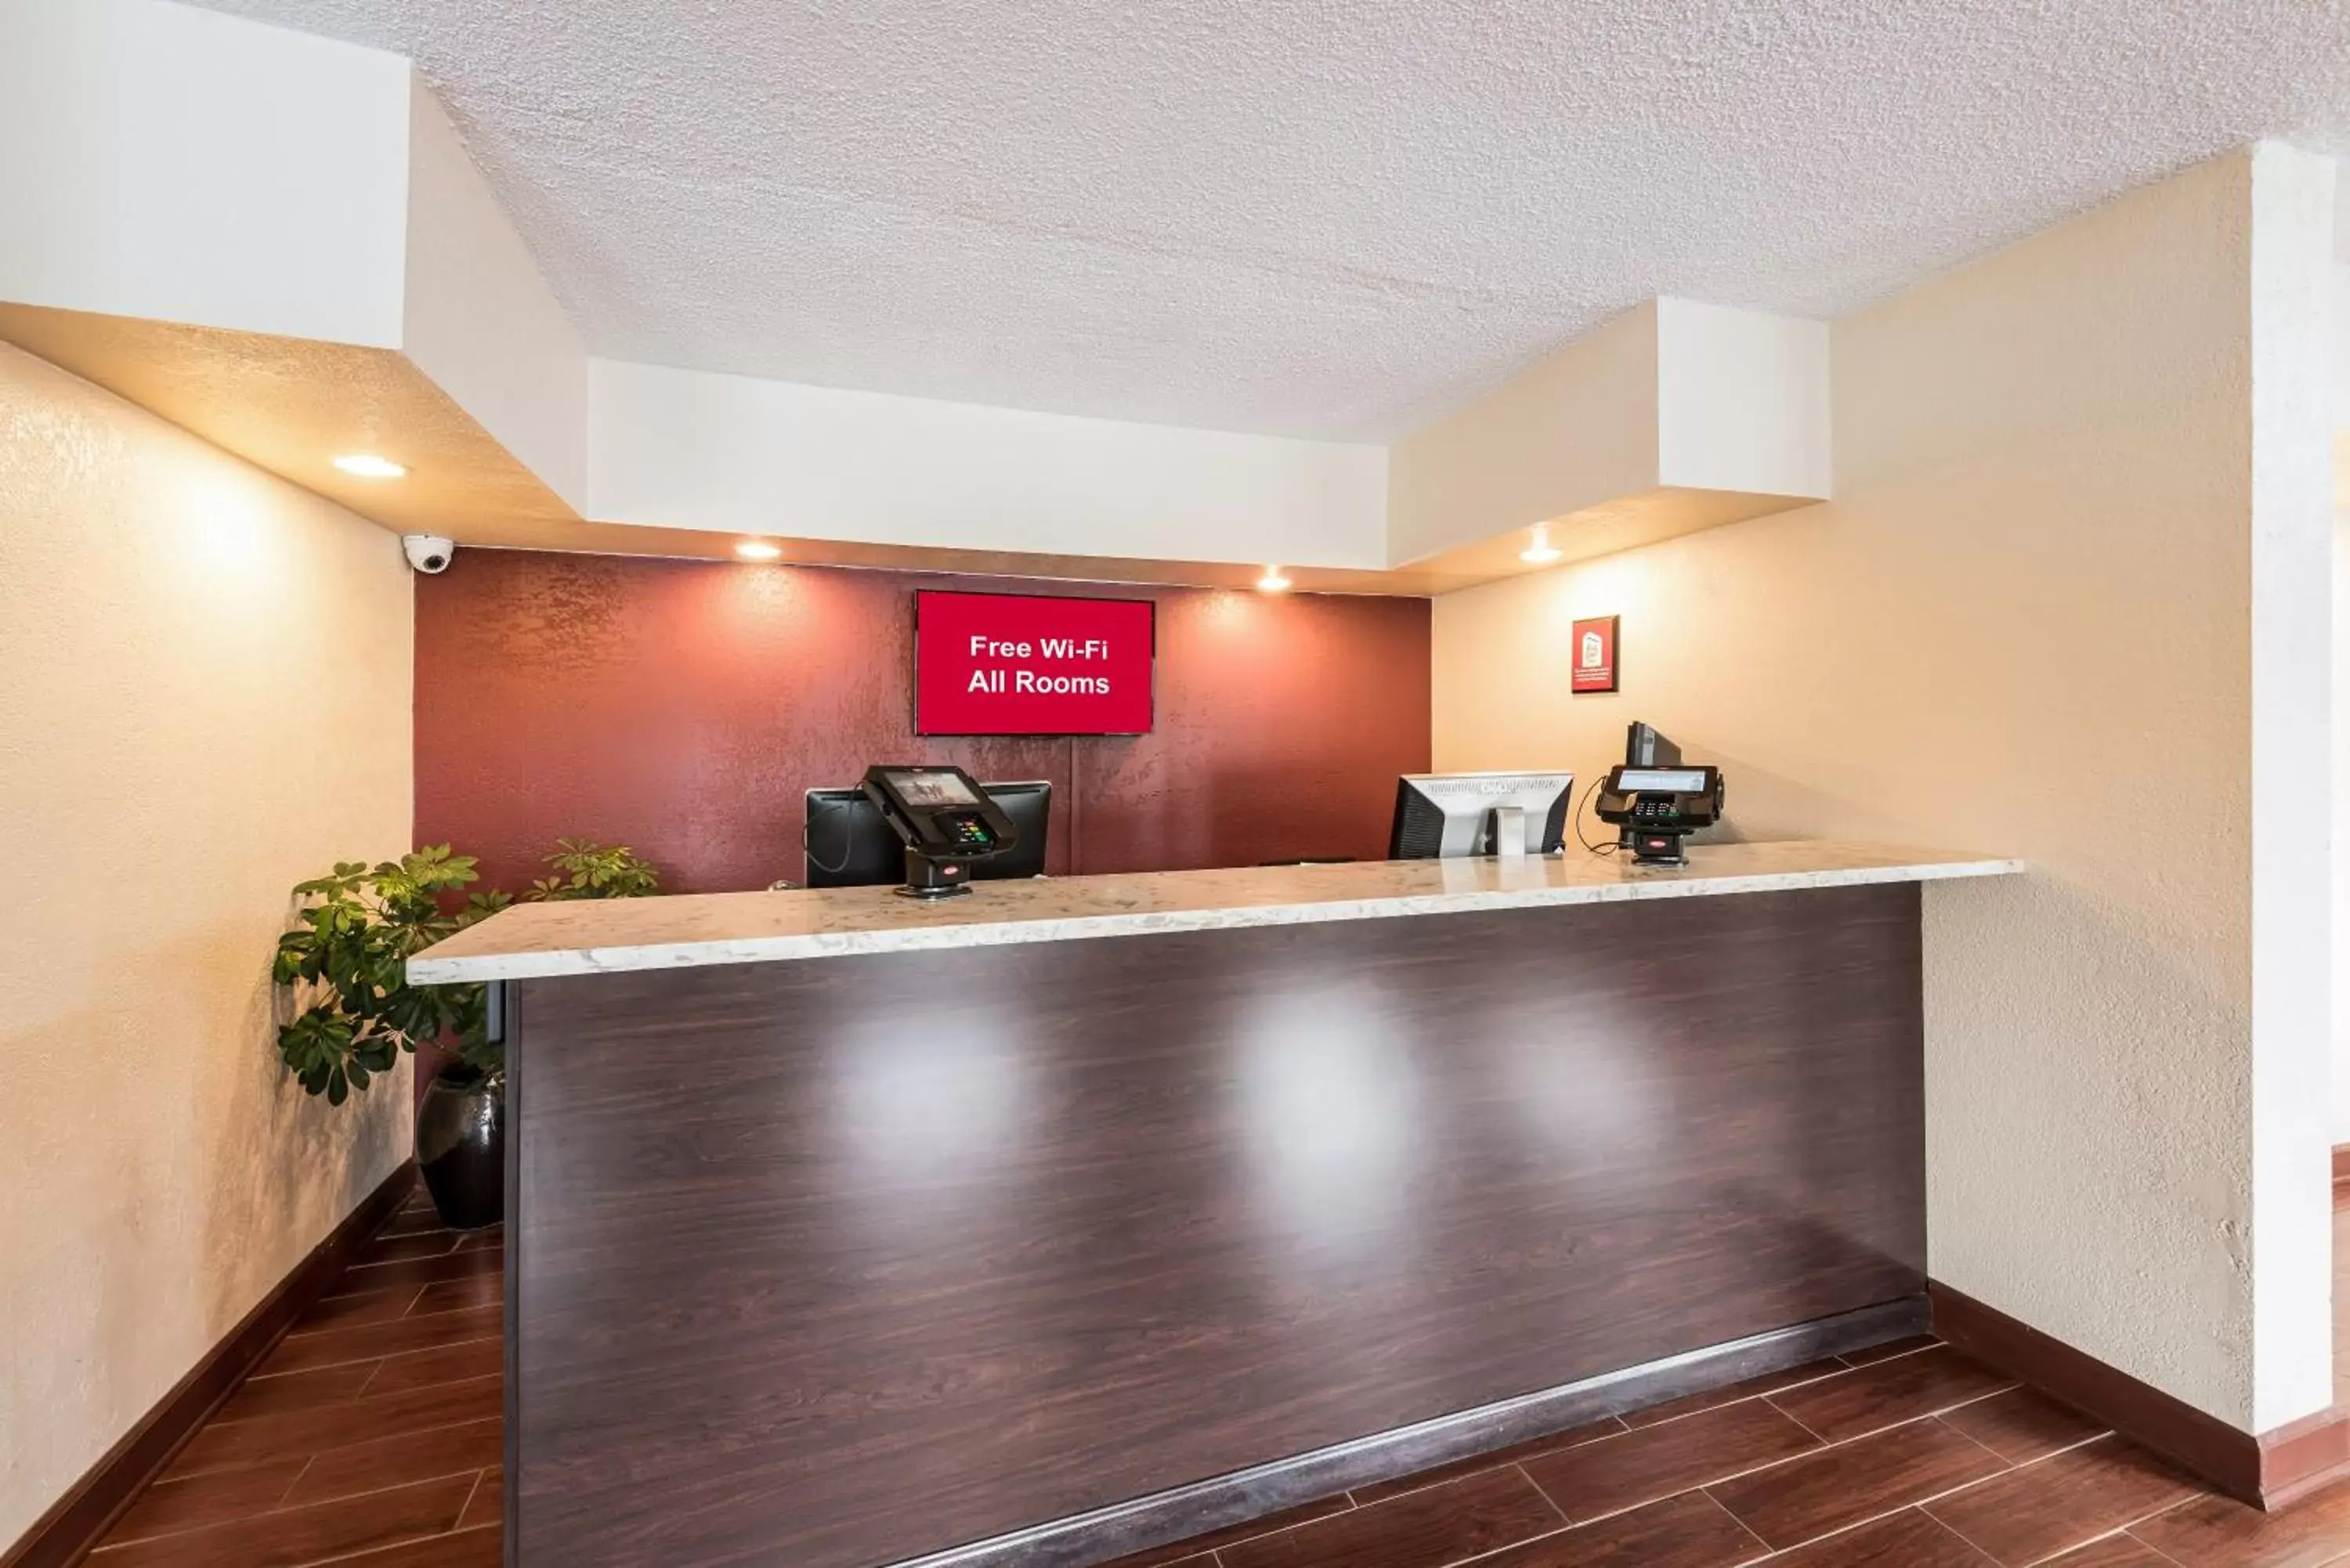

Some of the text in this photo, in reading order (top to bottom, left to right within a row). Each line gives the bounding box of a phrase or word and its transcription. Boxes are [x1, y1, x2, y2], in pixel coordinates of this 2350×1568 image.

[971, 636, 1108, 659] Free Wi-Fi
[967, 670, 1110, 694] All Rooms
